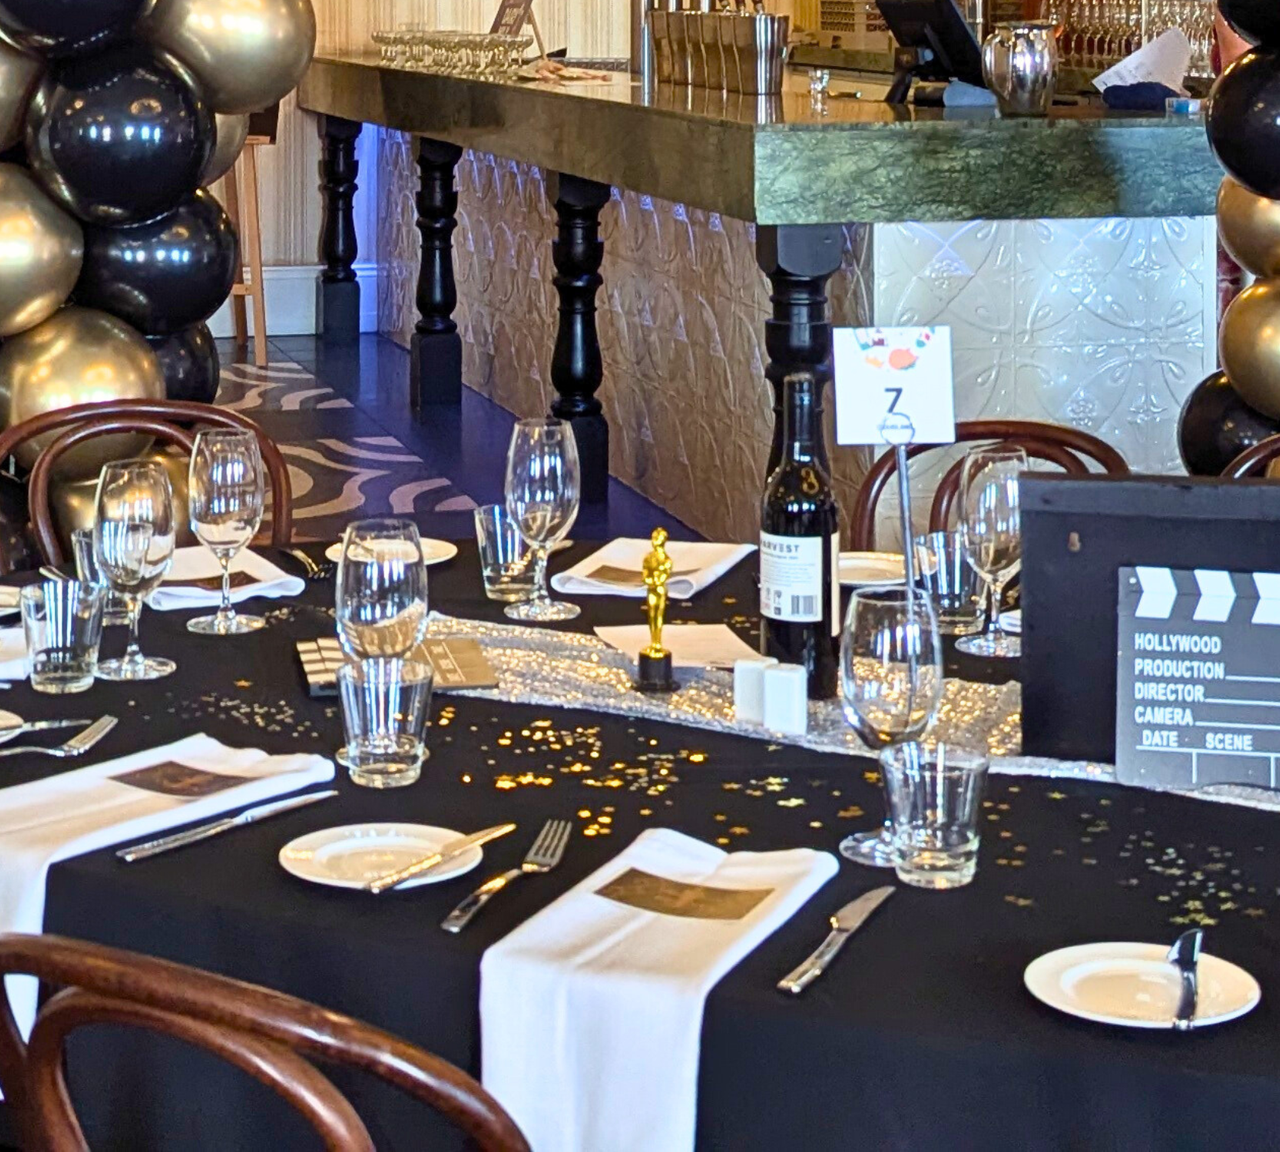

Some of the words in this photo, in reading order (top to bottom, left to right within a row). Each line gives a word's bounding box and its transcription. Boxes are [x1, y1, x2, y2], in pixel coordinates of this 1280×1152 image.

[884, 387, 903, 414] 7
[1134, 632, 1222, 654] HOLLYWOOD
[1134, 658, 1225, 680] PRODUCTION
[1134, 682, 1205, 703] DIRECTOR
[1134, 706, 1194, 726] CAMERA
[1142, 730, 1179, 747] DATE
[1205, 733, 1253, 750] SCENE
